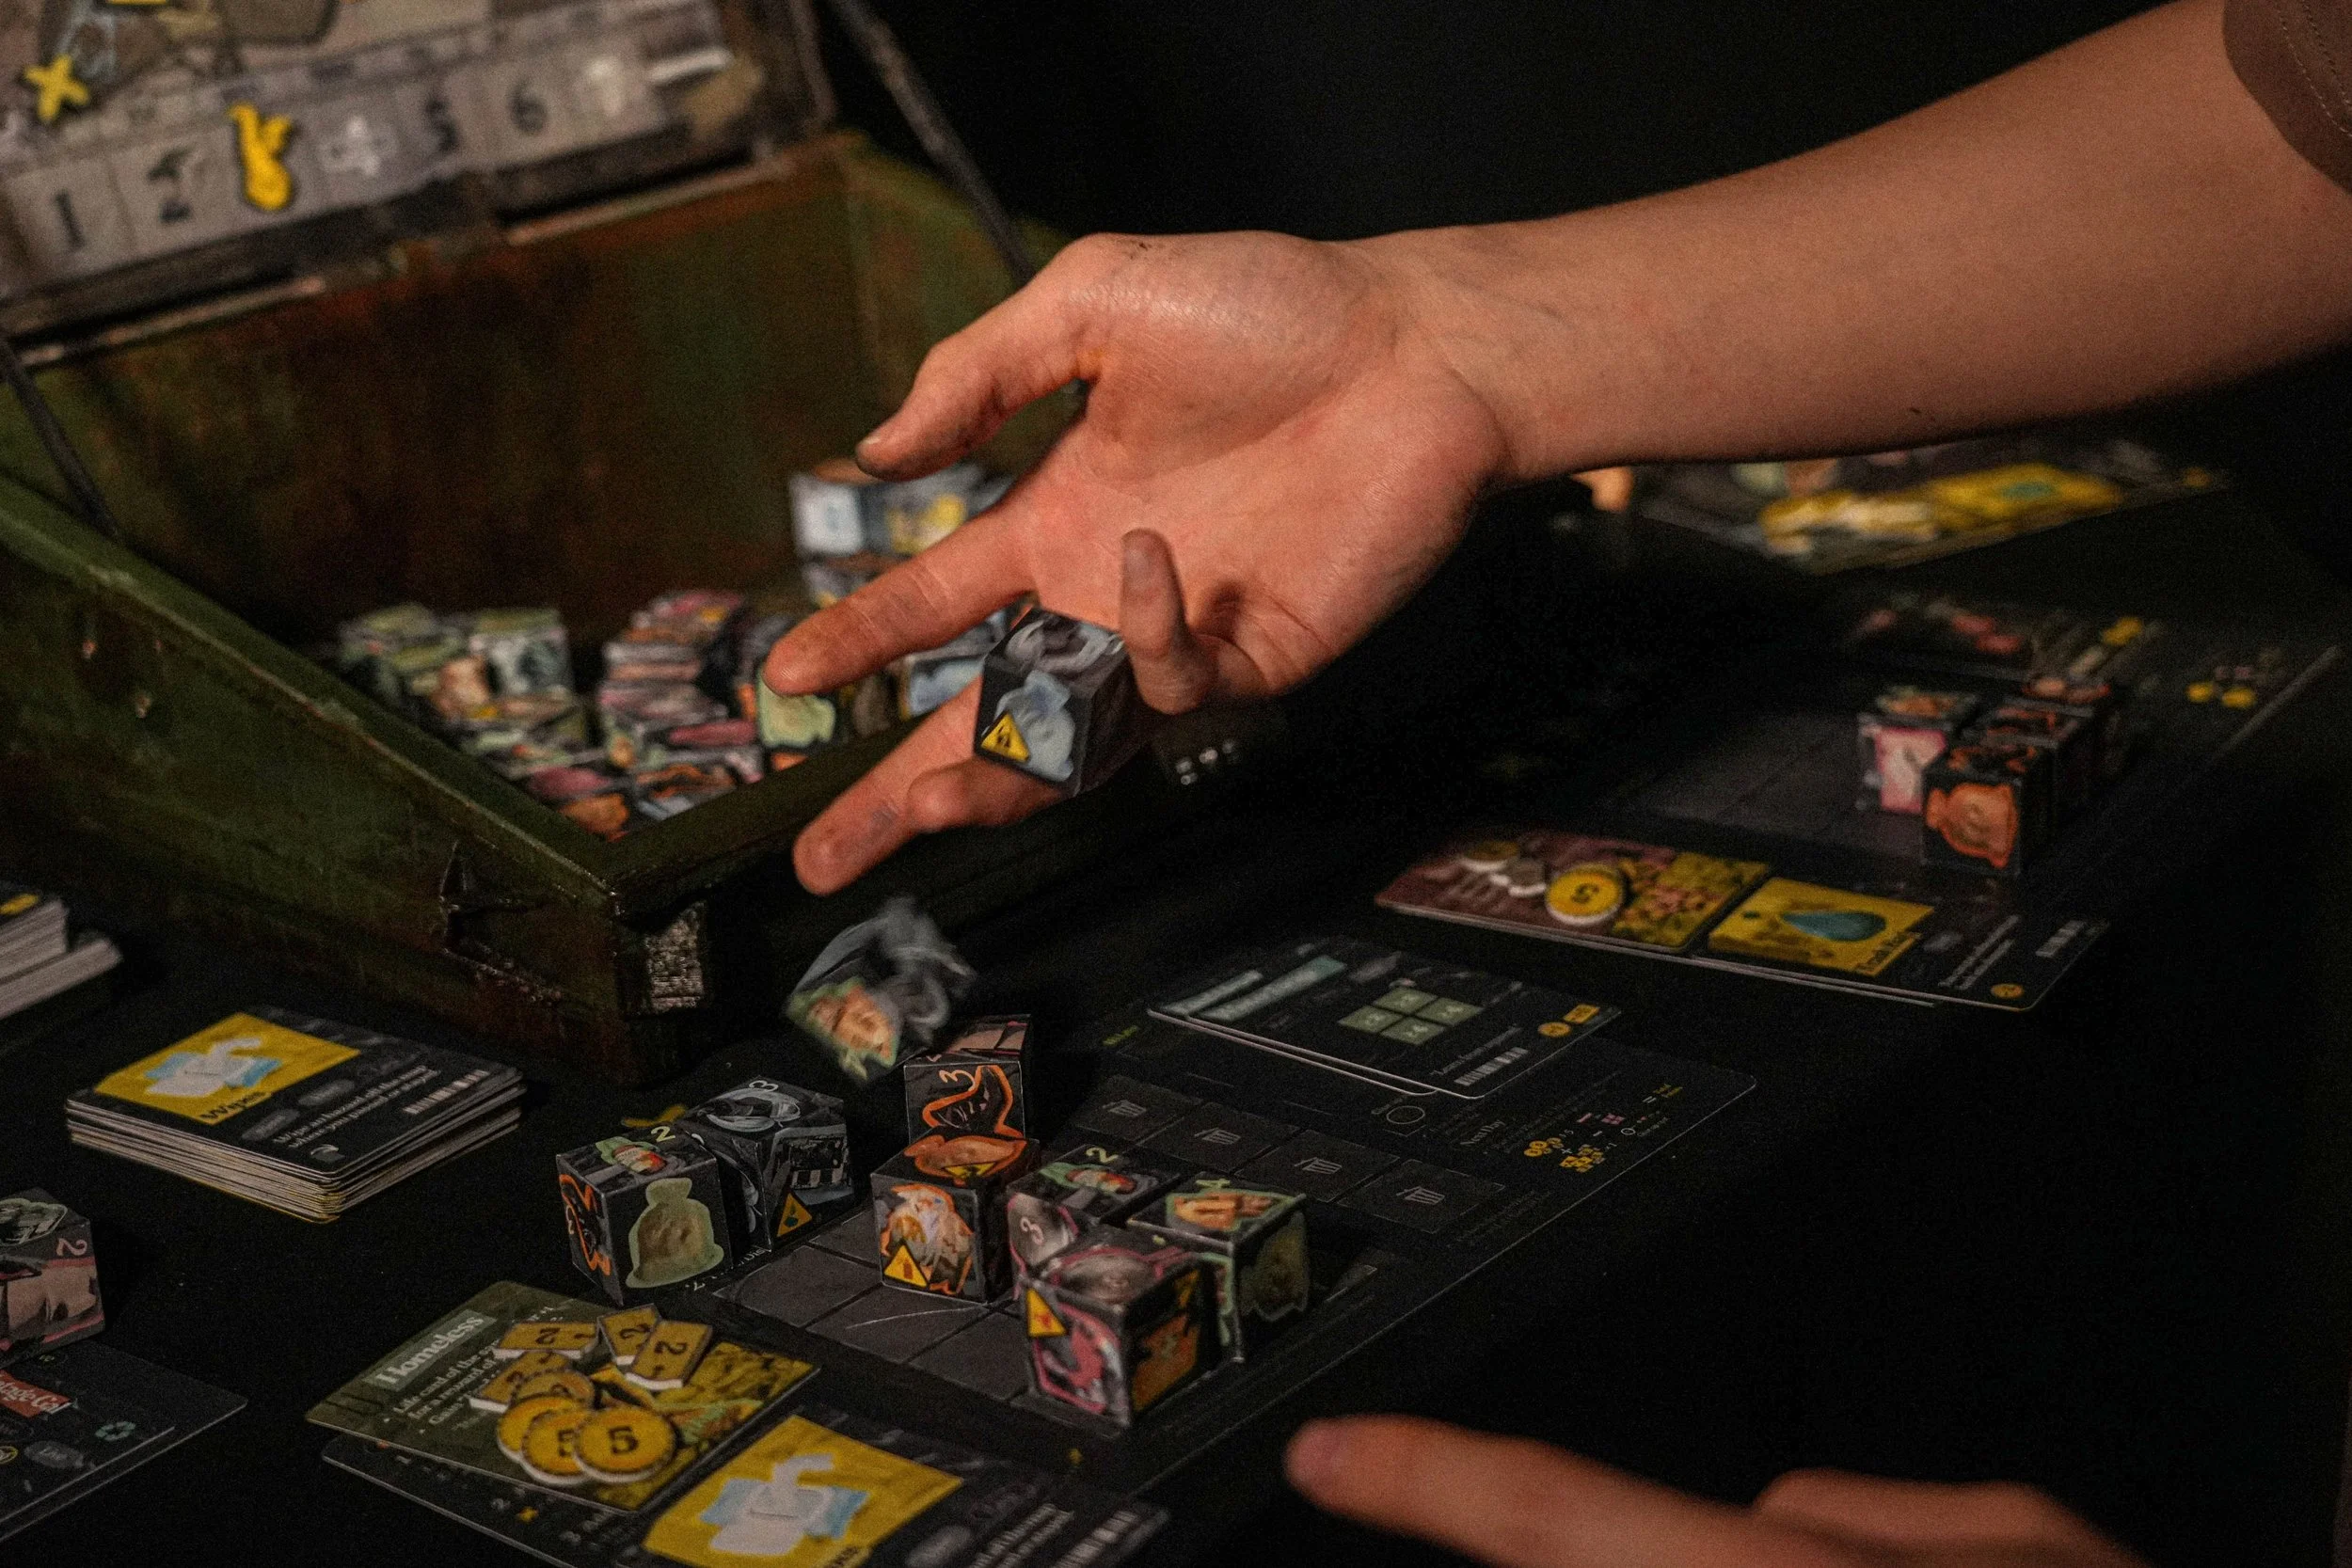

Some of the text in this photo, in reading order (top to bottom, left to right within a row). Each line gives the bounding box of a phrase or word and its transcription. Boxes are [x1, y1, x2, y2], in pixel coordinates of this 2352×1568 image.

[651, 1126, 675, 1142] 2
[1086, 1146, 1119, 1164] 2
[56, 1237, 88, 1257] 2
[375, 1316, 485, 1385] Homeless
[608, 1426, 639, 1455] 5
